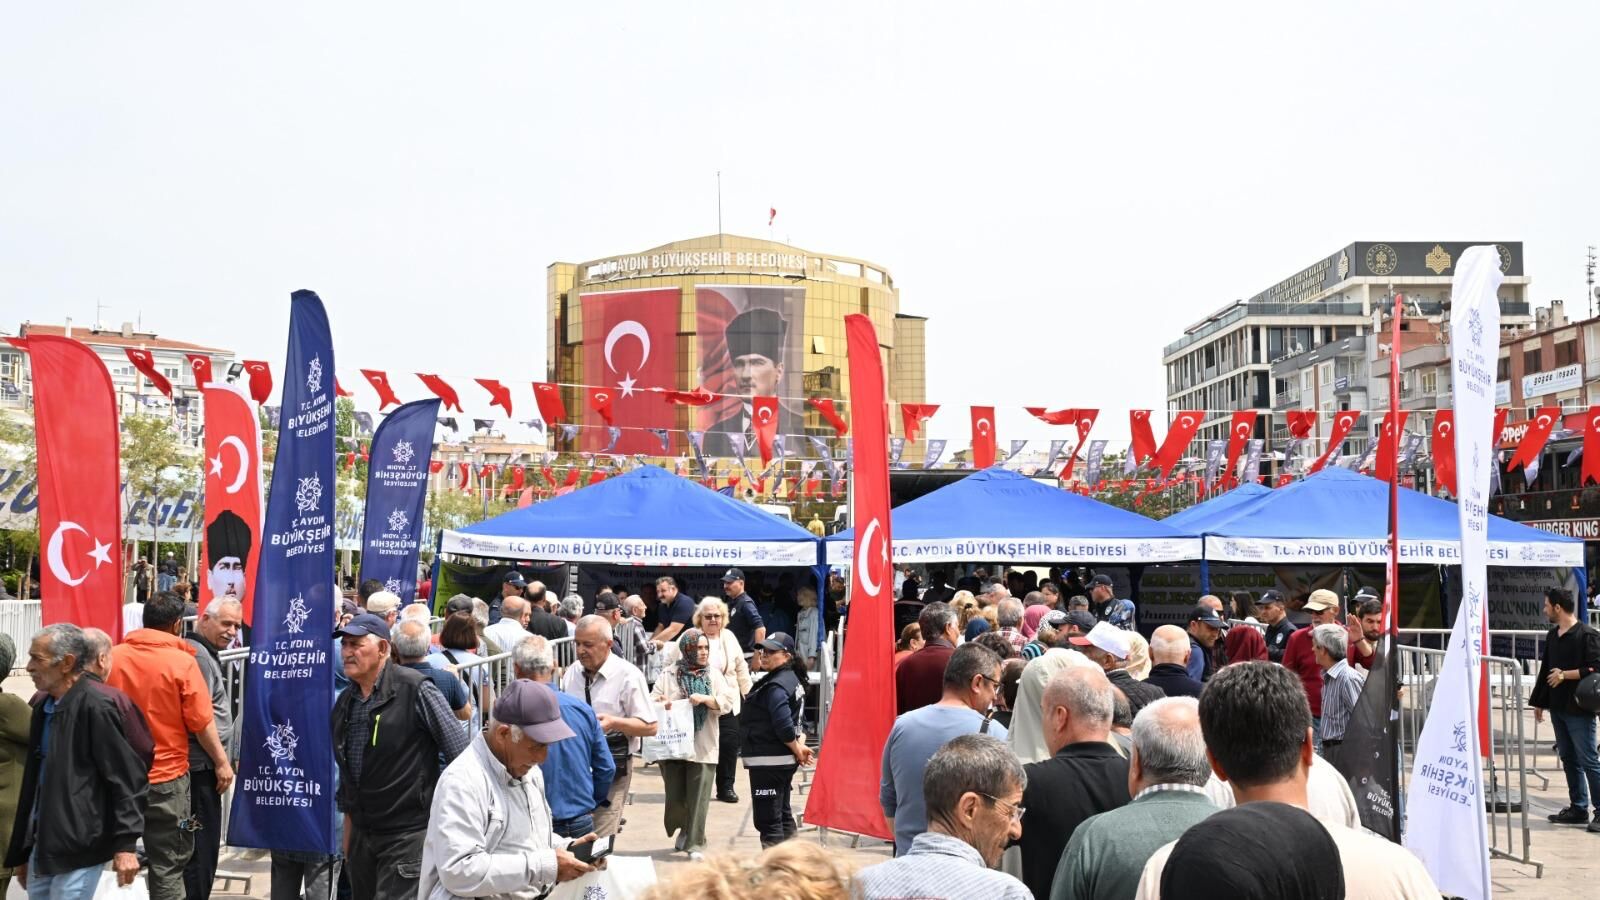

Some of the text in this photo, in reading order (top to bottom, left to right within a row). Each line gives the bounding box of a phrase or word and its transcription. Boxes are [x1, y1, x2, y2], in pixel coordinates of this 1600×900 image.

[617, 255, 648, 272] AYDIN
[1572, 521, 1599, 537] KING
[509, 542, 529, 552] T.C.
[532, 543, 569, 555] AYDIN
[573, 541, 668, 560] BÜYÜKŞEHİR
[672, 546, 742, 559] BELEDİYESİ
[915, 545, 952, 555] AYDIN
[956, 541, 1051, 559] BÜYÜKŞEHİR
[1057, 544, 1127, 557] BELEDİYESİ
[1298, 545, 1334, 556] AYDIN
[1338, 541, 1434, 559] BÜYÜKEHİR
[1438, 546, 1509, 560] BELESİ
[258, 765, 274, 775] T.C.
[255, 795, 314, 808] BELEDİYESİ
